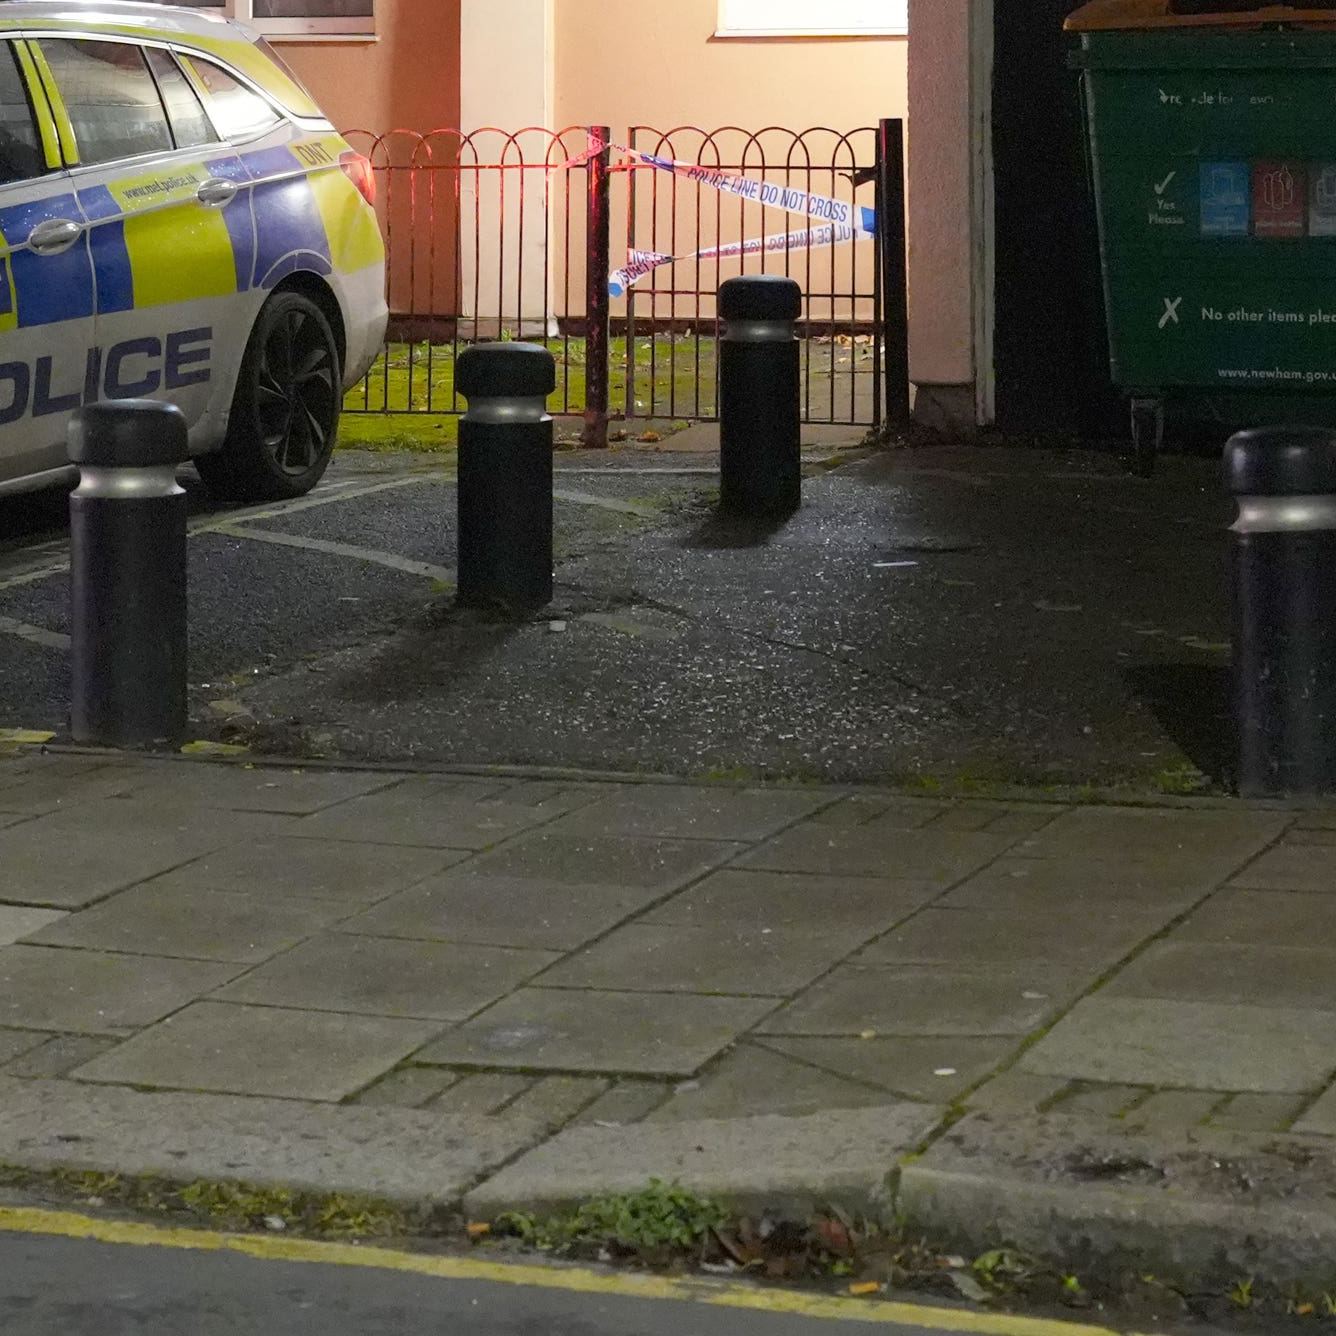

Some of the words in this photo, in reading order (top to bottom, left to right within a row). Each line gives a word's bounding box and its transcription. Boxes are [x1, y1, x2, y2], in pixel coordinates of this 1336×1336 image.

[122, 173, 200, 200] www.met.police.uk
[687, 167, 731, 191] POLICE
[730, 176, 759, 198] LINE
[759, 182, 778, 204] DO
[781, 187, 807, 211] NOT
[807, 195, 848, 222] CROSS
[1155, 199, 1176, 212] Yes
[1148, 213, 1184, 225] Please
[1201, 307, 1223, 321] No
[1227, 308, 1264, 322] other
[1268, 309, 1304, 323] items
